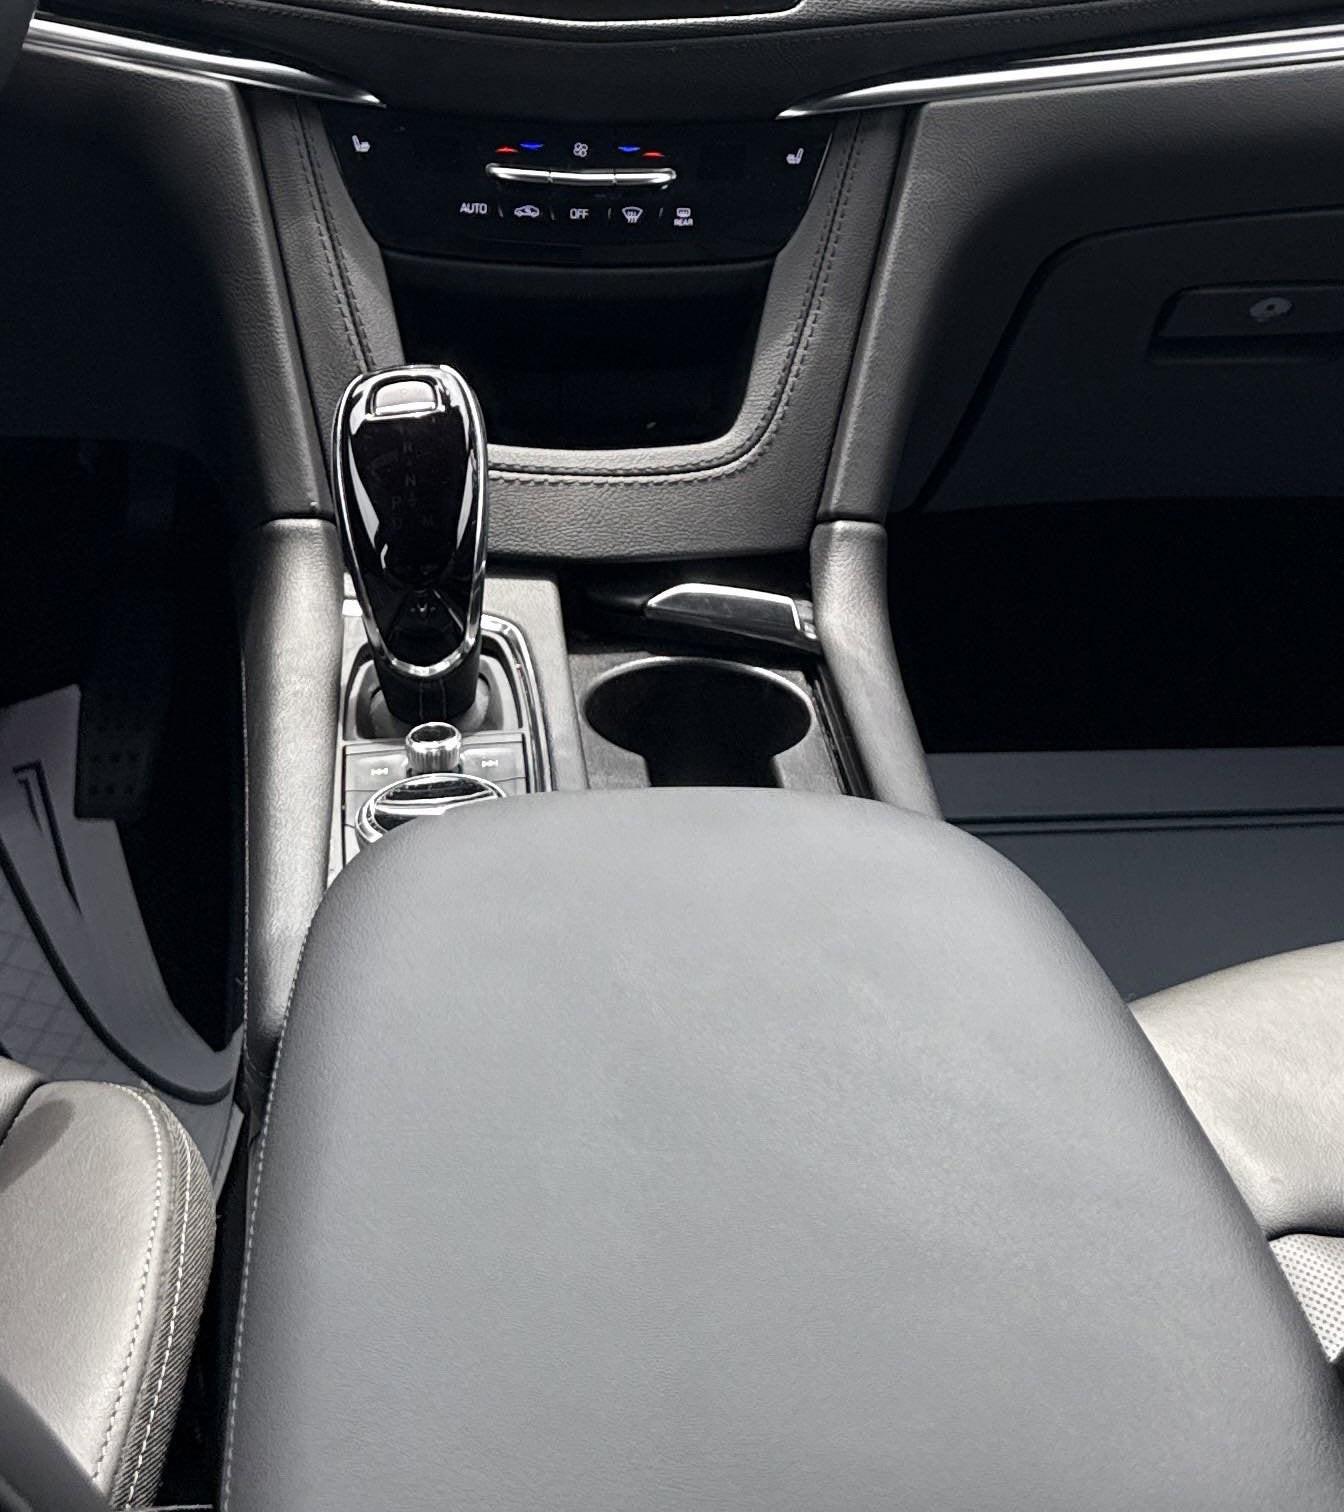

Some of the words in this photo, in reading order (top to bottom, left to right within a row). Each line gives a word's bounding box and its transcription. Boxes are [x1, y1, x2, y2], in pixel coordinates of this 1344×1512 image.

[459, 202, 488, 215] AUTO
[569, 207, 590, 220] OFF
[673, 217, 694, 227] REAR
